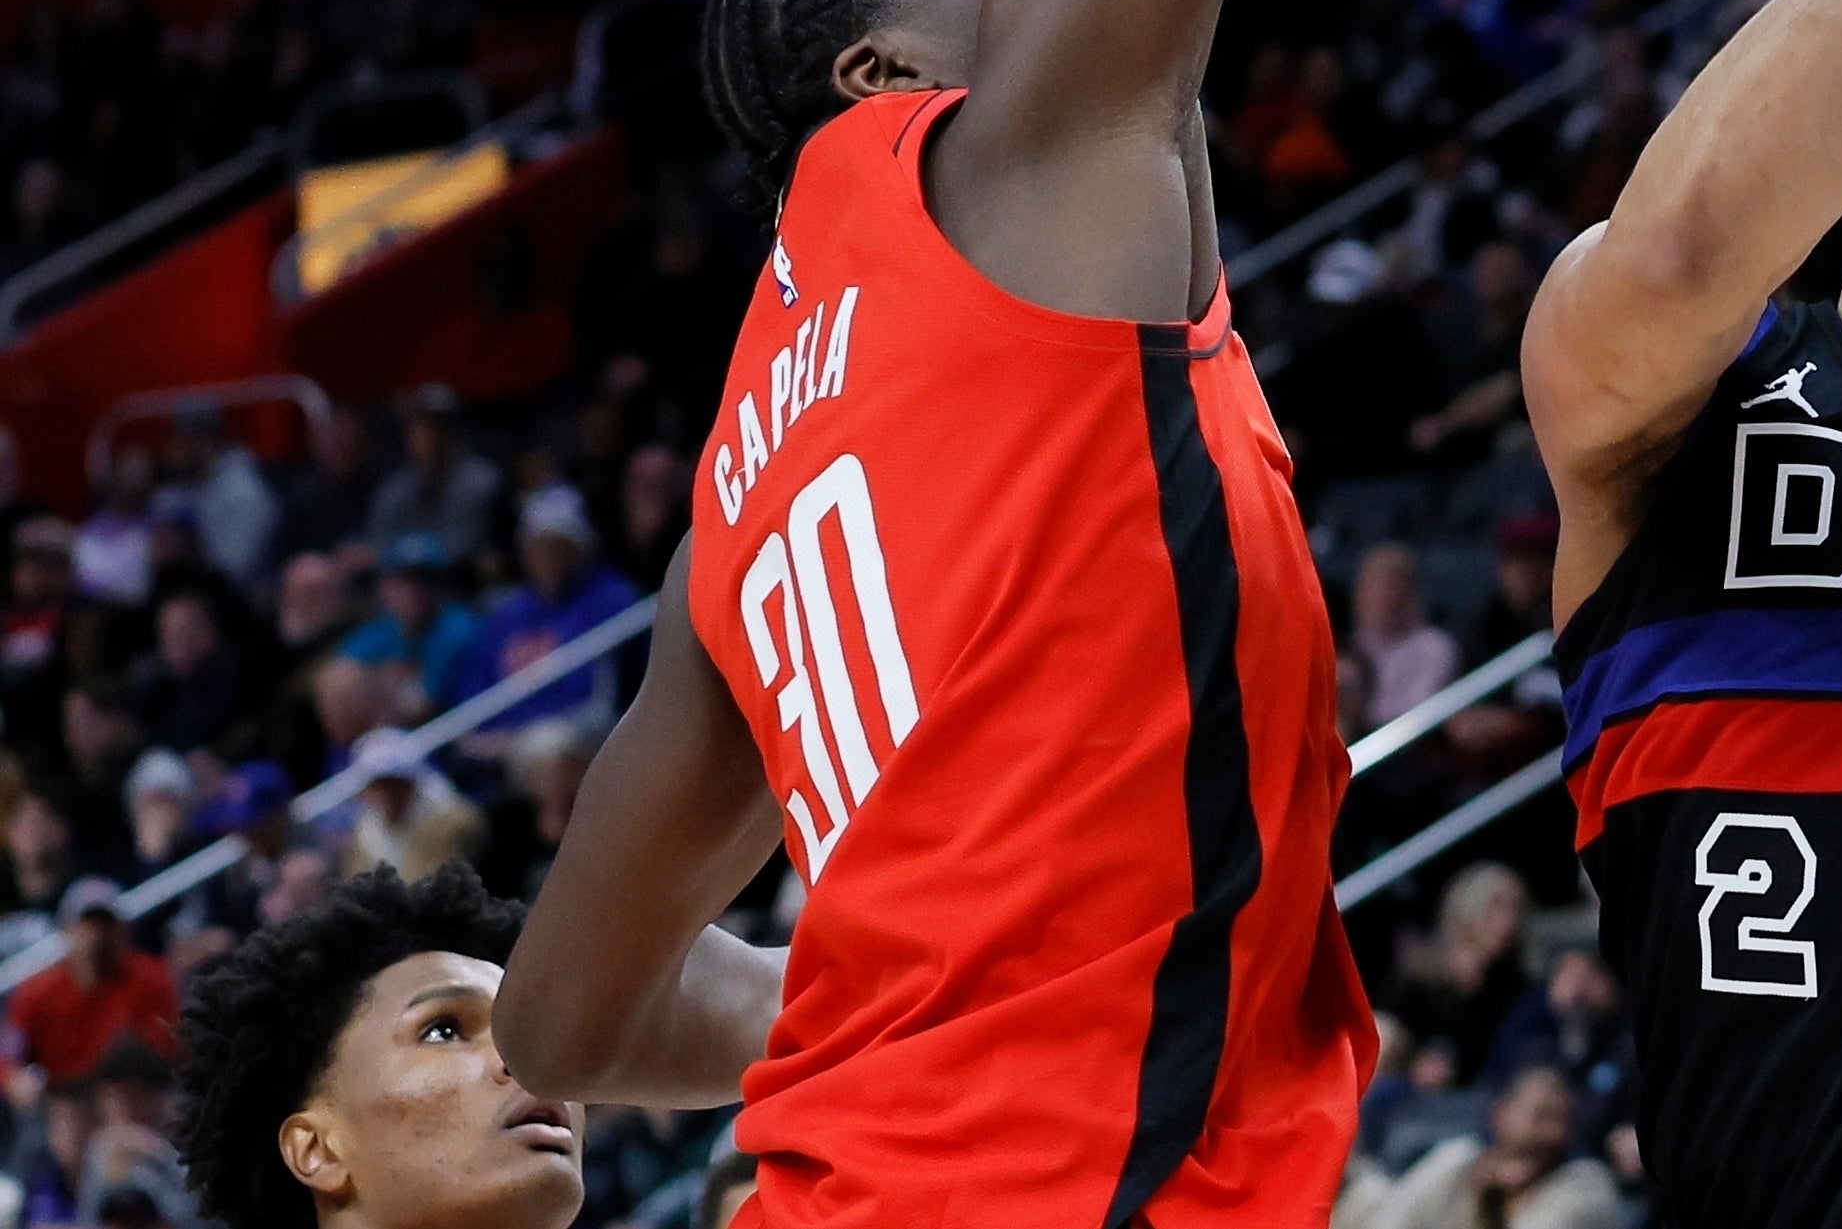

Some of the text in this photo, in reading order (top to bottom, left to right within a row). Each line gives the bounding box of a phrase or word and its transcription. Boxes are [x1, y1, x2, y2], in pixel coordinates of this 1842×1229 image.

[713, 285, 860, 527] CAPELA
[740, 453, 921, 889] 30
[1695, 812, 1818, 998] 2
